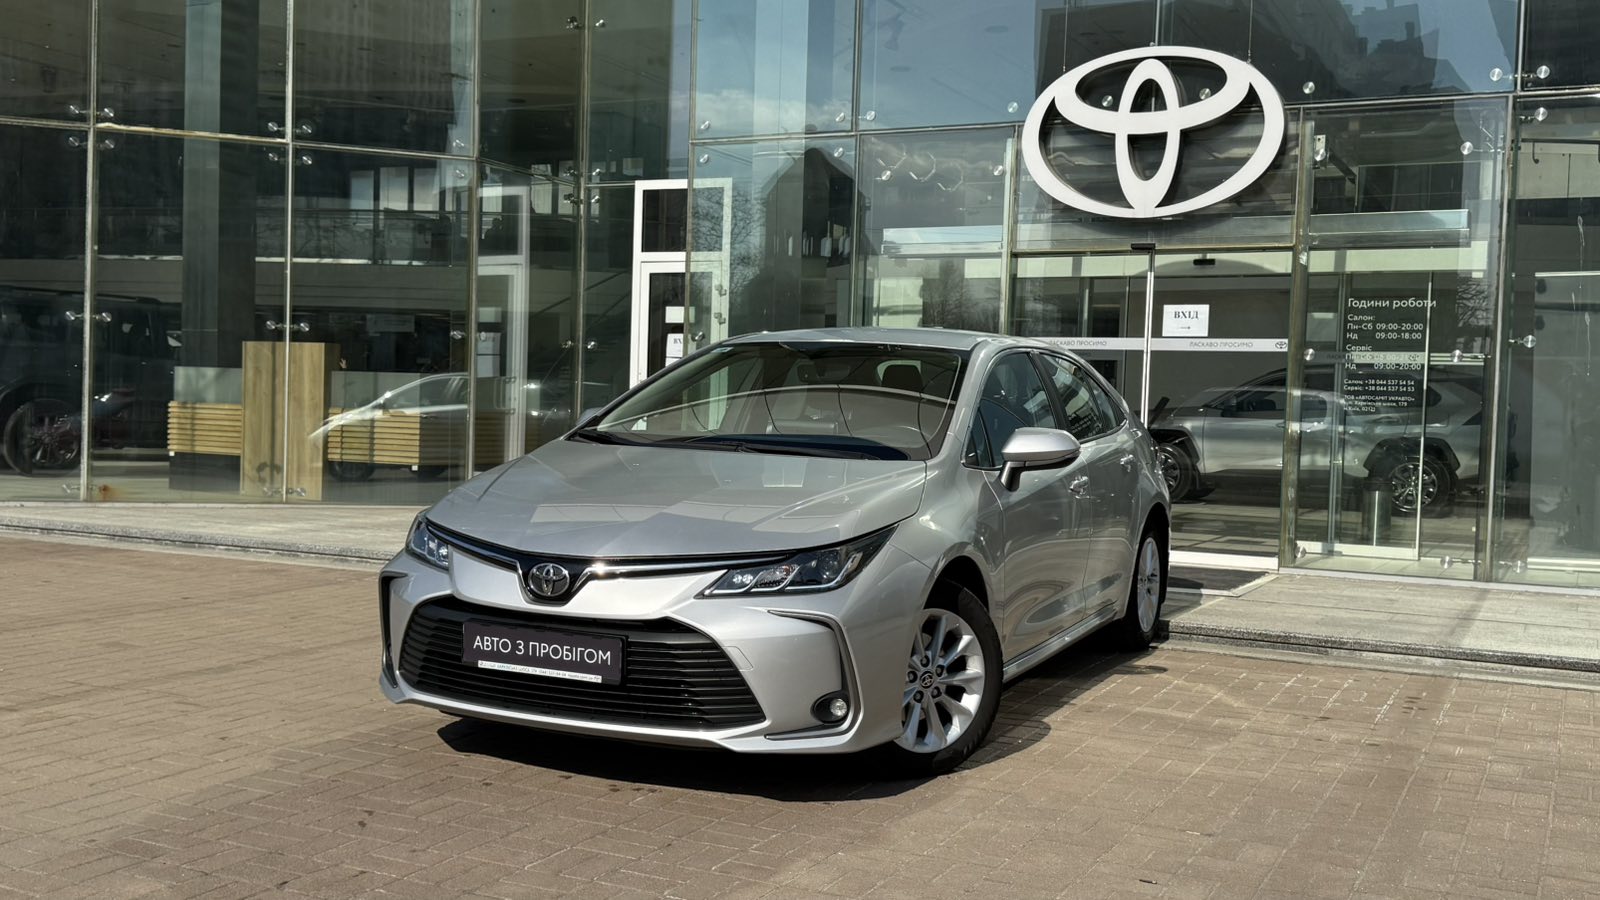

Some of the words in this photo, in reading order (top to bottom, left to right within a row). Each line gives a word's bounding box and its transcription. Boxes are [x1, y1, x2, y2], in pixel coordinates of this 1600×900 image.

[1348, 298, 1390, 309] Години
[1392, 297, 1437, 309] роботи
[1174, 310, 1200, 320] ВХІД
[1347, 322, 1373, 330] Пн-Сб
[1346, 332, 1359, 340] Нд
[1375, 332, 1422, 340] 09:00-18:00
[1374, 363, 1422, 371] 09:00-20:00
[473, 635, 512, 653] АВТО
[515, 640, 525, 655] З
[529, 641, 611, 666] ПРОБІГОМ
